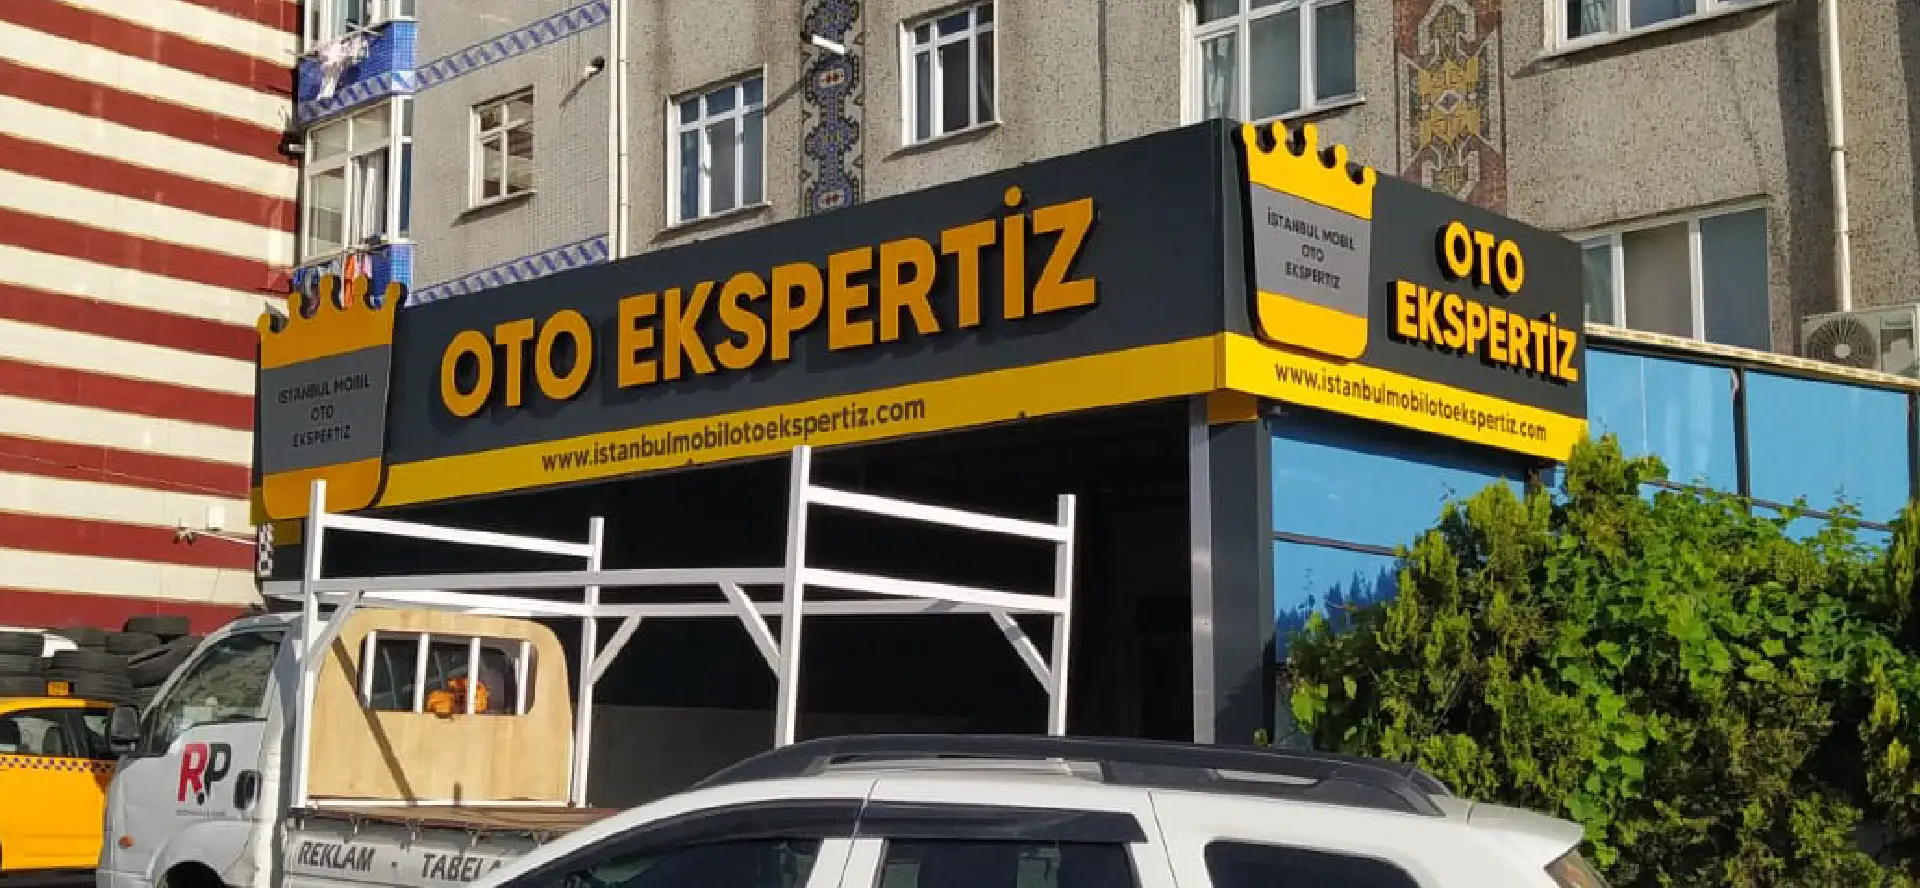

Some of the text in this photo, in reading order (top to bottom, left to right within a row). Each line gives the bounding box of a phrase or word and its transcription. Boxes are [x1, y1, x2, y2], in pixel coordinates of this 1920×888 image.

[1301, 244, 1325, 263] OTO
[1444, 221, 1525, 293] OTO
[441, 186, 1096, 416] OTO EKSPERTİZ
[1396, 281, 1579, 382] EKSPERTİZ
[310, 405, 334, 421] OTO
[542, 398, 925, 471] www.istanbulmobilotoekspertiz.com
[1274, 362, 1547, 443] www.istanbulmobilotoekspertiz.com
[298, 841, 376, 872] REKLAM
